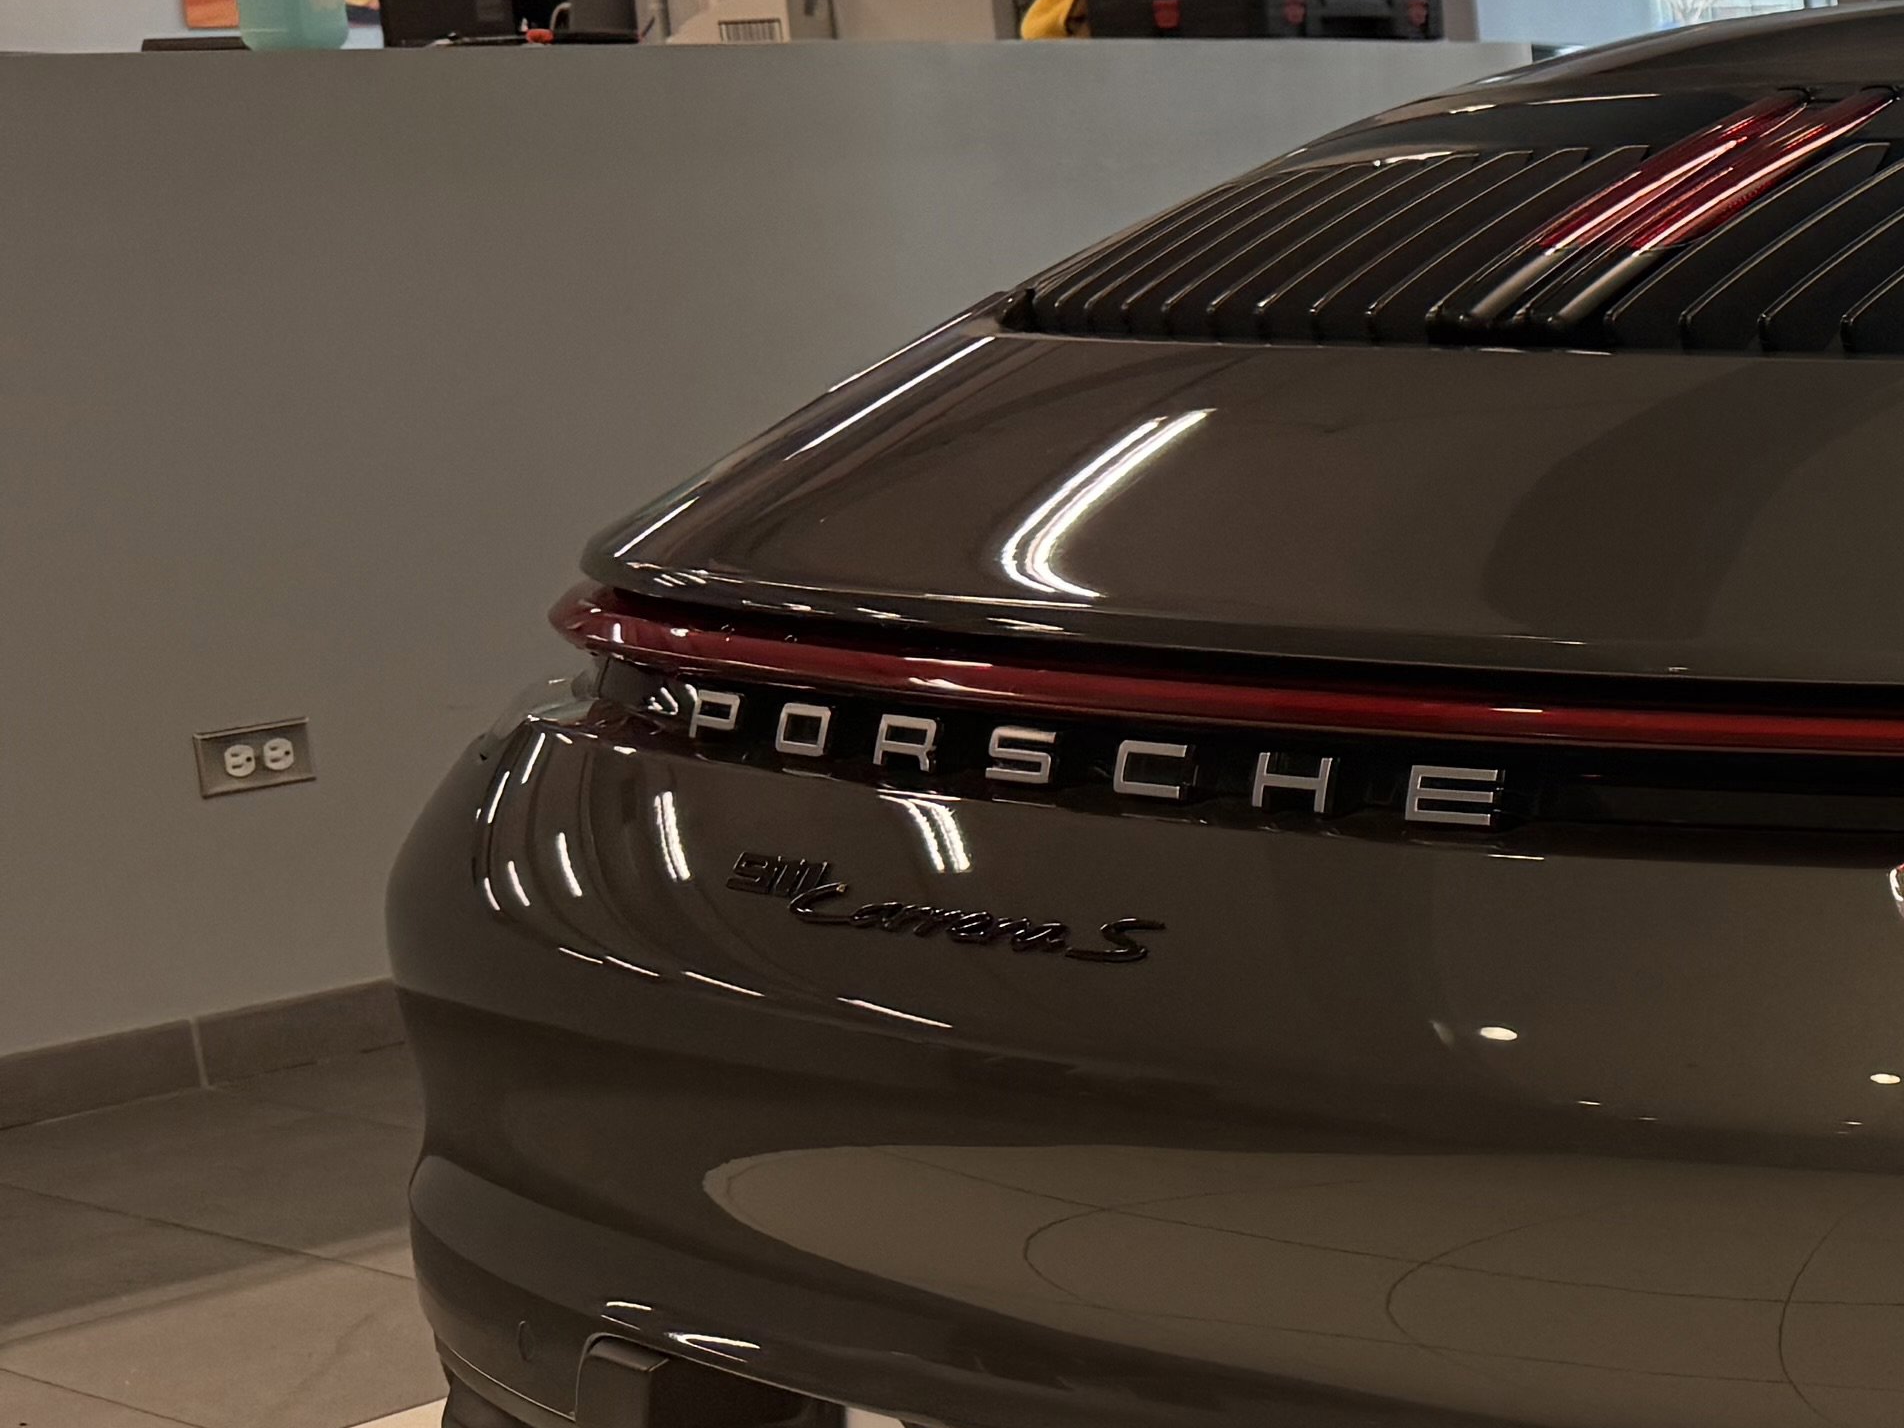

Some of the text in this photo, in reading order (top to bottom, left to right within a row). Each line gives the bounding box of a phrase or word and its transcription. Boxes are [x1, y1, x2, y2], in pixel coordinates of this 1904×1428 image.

[688, 688, 1503, 828] PORSCHE
[726, 851, 832, 898] 911
[787, 881, 1166, 963] Carrera S
